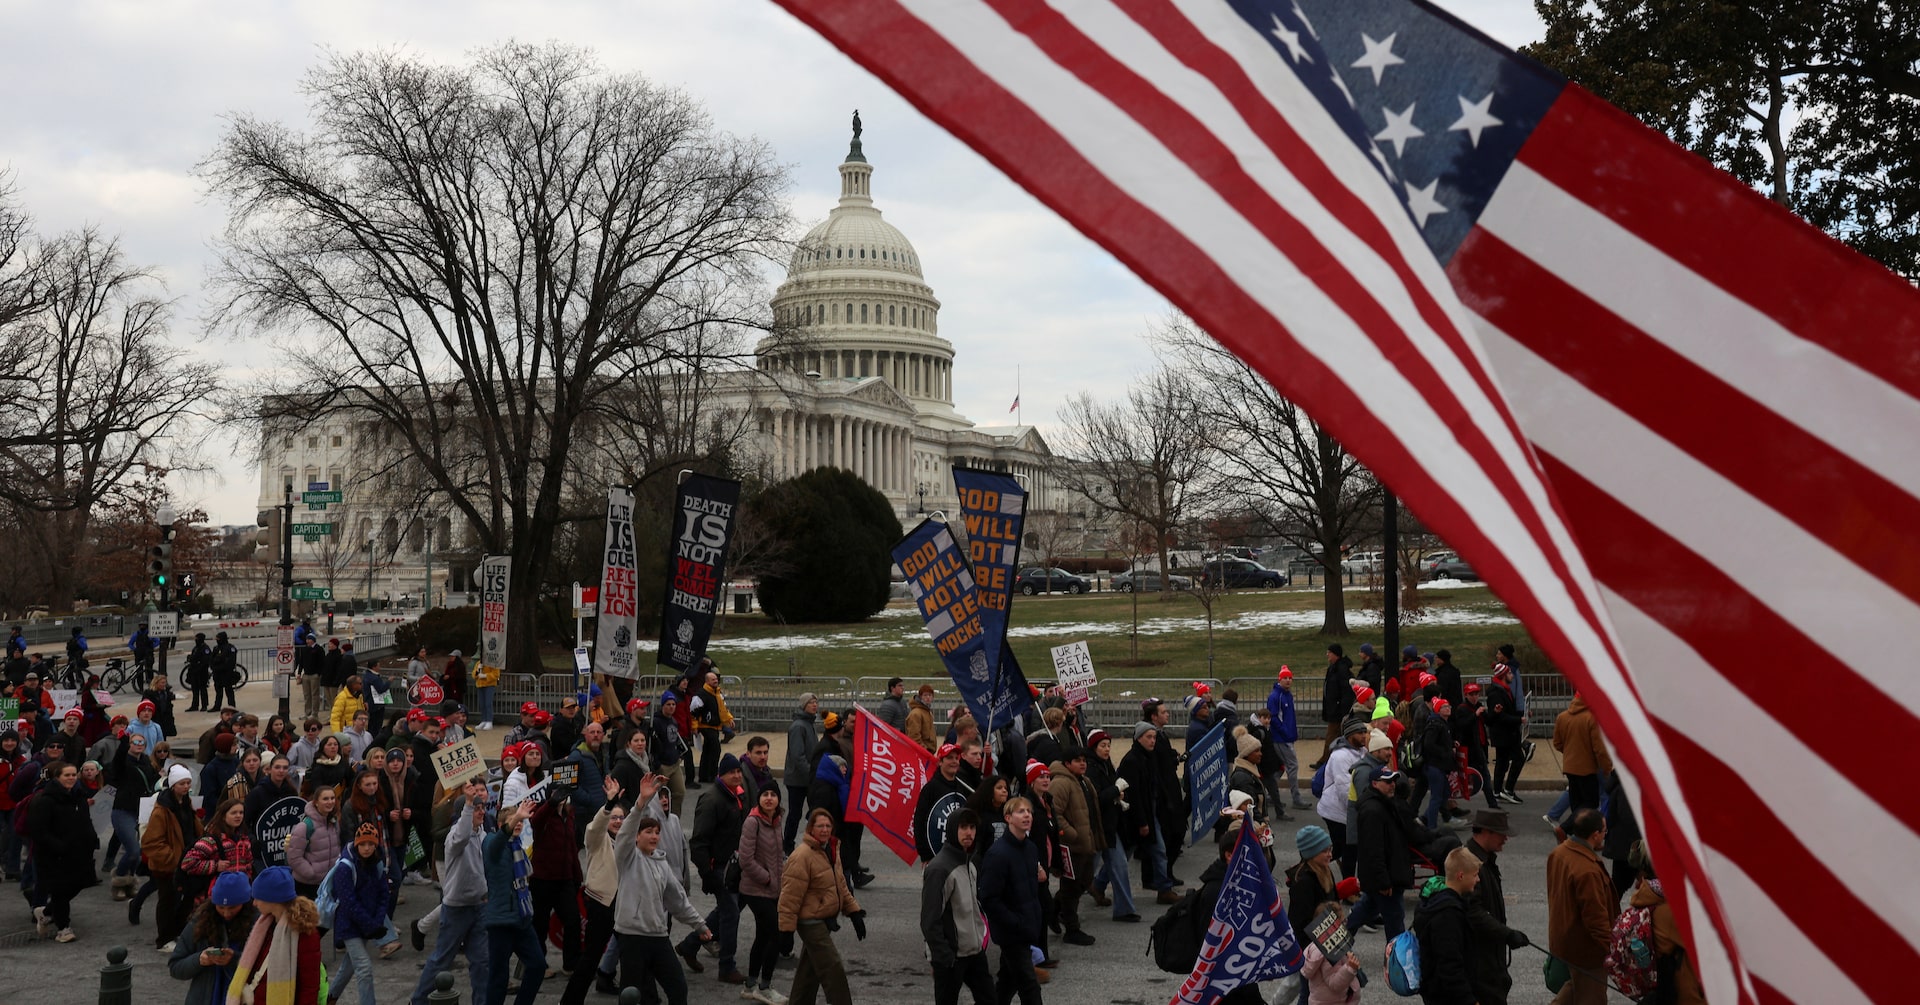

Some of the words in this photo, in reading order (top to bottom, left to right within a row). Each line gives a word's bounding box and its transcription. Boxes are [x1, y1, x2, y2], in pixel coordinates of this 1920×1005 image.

[305, 493, 334, 504] Independence
[683, 495, 733, 518] DEATH
[293, 524, 324, 534] CAPITOL
[609, 520, 633, 552] IS
[680, 508, 728, 548] IS
[963, 514, 1016, 540] WILL
[677, 540, 722, 567] NOT
[902, 541, 937, 578] GOD
[486, 565, 507, 575] LIFE
[677, 557, 717, 583] WEL
[919, 552, 962, 592] WILL
[975, 566, 1006, 589] BE
[485, 575, 506, 593] IS
[673, 574, 716, 599] COME
[484, 592, 505, 603] OUR
[670, 588, 714, 615] HERE!
[923, 577, 960, 616] NOT
[484, 612, 504, 622] LUT
[950, 593, 979, 624] BE
[484, 621, 505, 633] ION!
[937, 614, 982, 657] MOCKE
[610, 650, 633, 660] WHITE
[671, 642, 696, 657] WHITE
[673, 651, 691, 662] ROSE
[1055, 652, 1090, 668] BETA
[1056, 646, 1071, 657] UR
[1074, 643, 1082, 653] A
[1059, 663, 1090, 679] MALE
[1064, 676, 1096, 691] ABORTION
[3, 699, 18, 709] LIFE
[437, 743, 475, 766] LIFE
[441, 763, 454, 773] IS
[456, 752, 478, 767] OUR
[443, 758, 479, 779] REVOLUTION
[266, 806, 288, 827] LIFE
[289, 805, 299, 815] IS
[942, 802, 960, 817] LIFE
